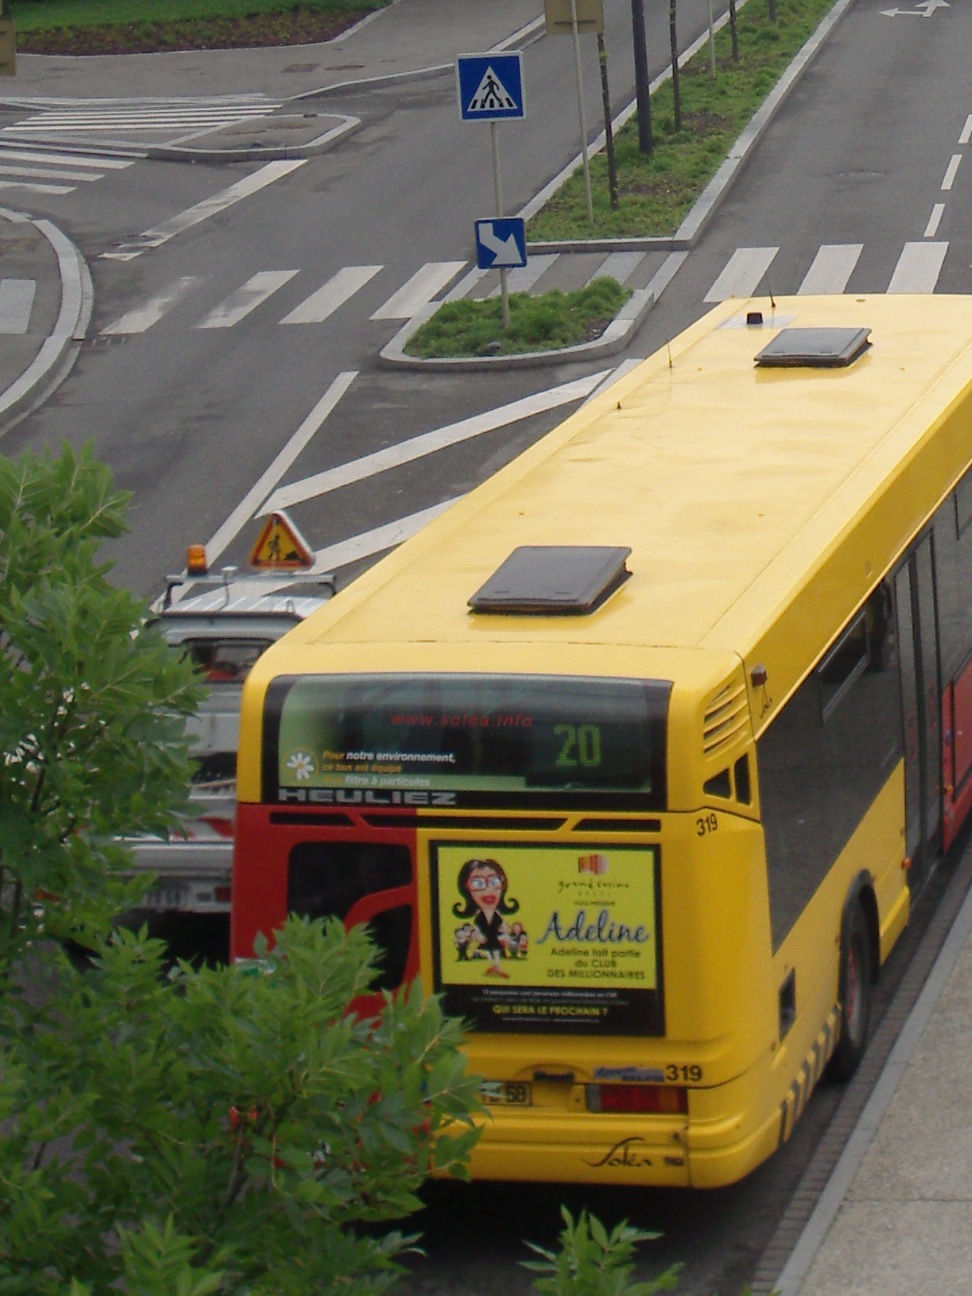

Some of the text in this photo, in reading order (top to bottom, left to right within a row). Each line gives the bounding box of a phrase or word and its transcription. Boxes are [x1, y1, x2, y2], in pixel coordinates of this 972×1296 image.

[553, 723, 602, 767] 20
[322, 750, 456, 764] Pour notre environnement,
[278, 788, 456, 805] HEULIEZ
[696, 812, 718, 837] 319
[536, 909, 650, 944] Adeline
[550, 948, 589, 957] Adeline
[575, 959, 617, 969] du CLUB
[547, 968, 646, 980] DES MILLIONNAIRES
[666, 1065, 702, 1082] 319
